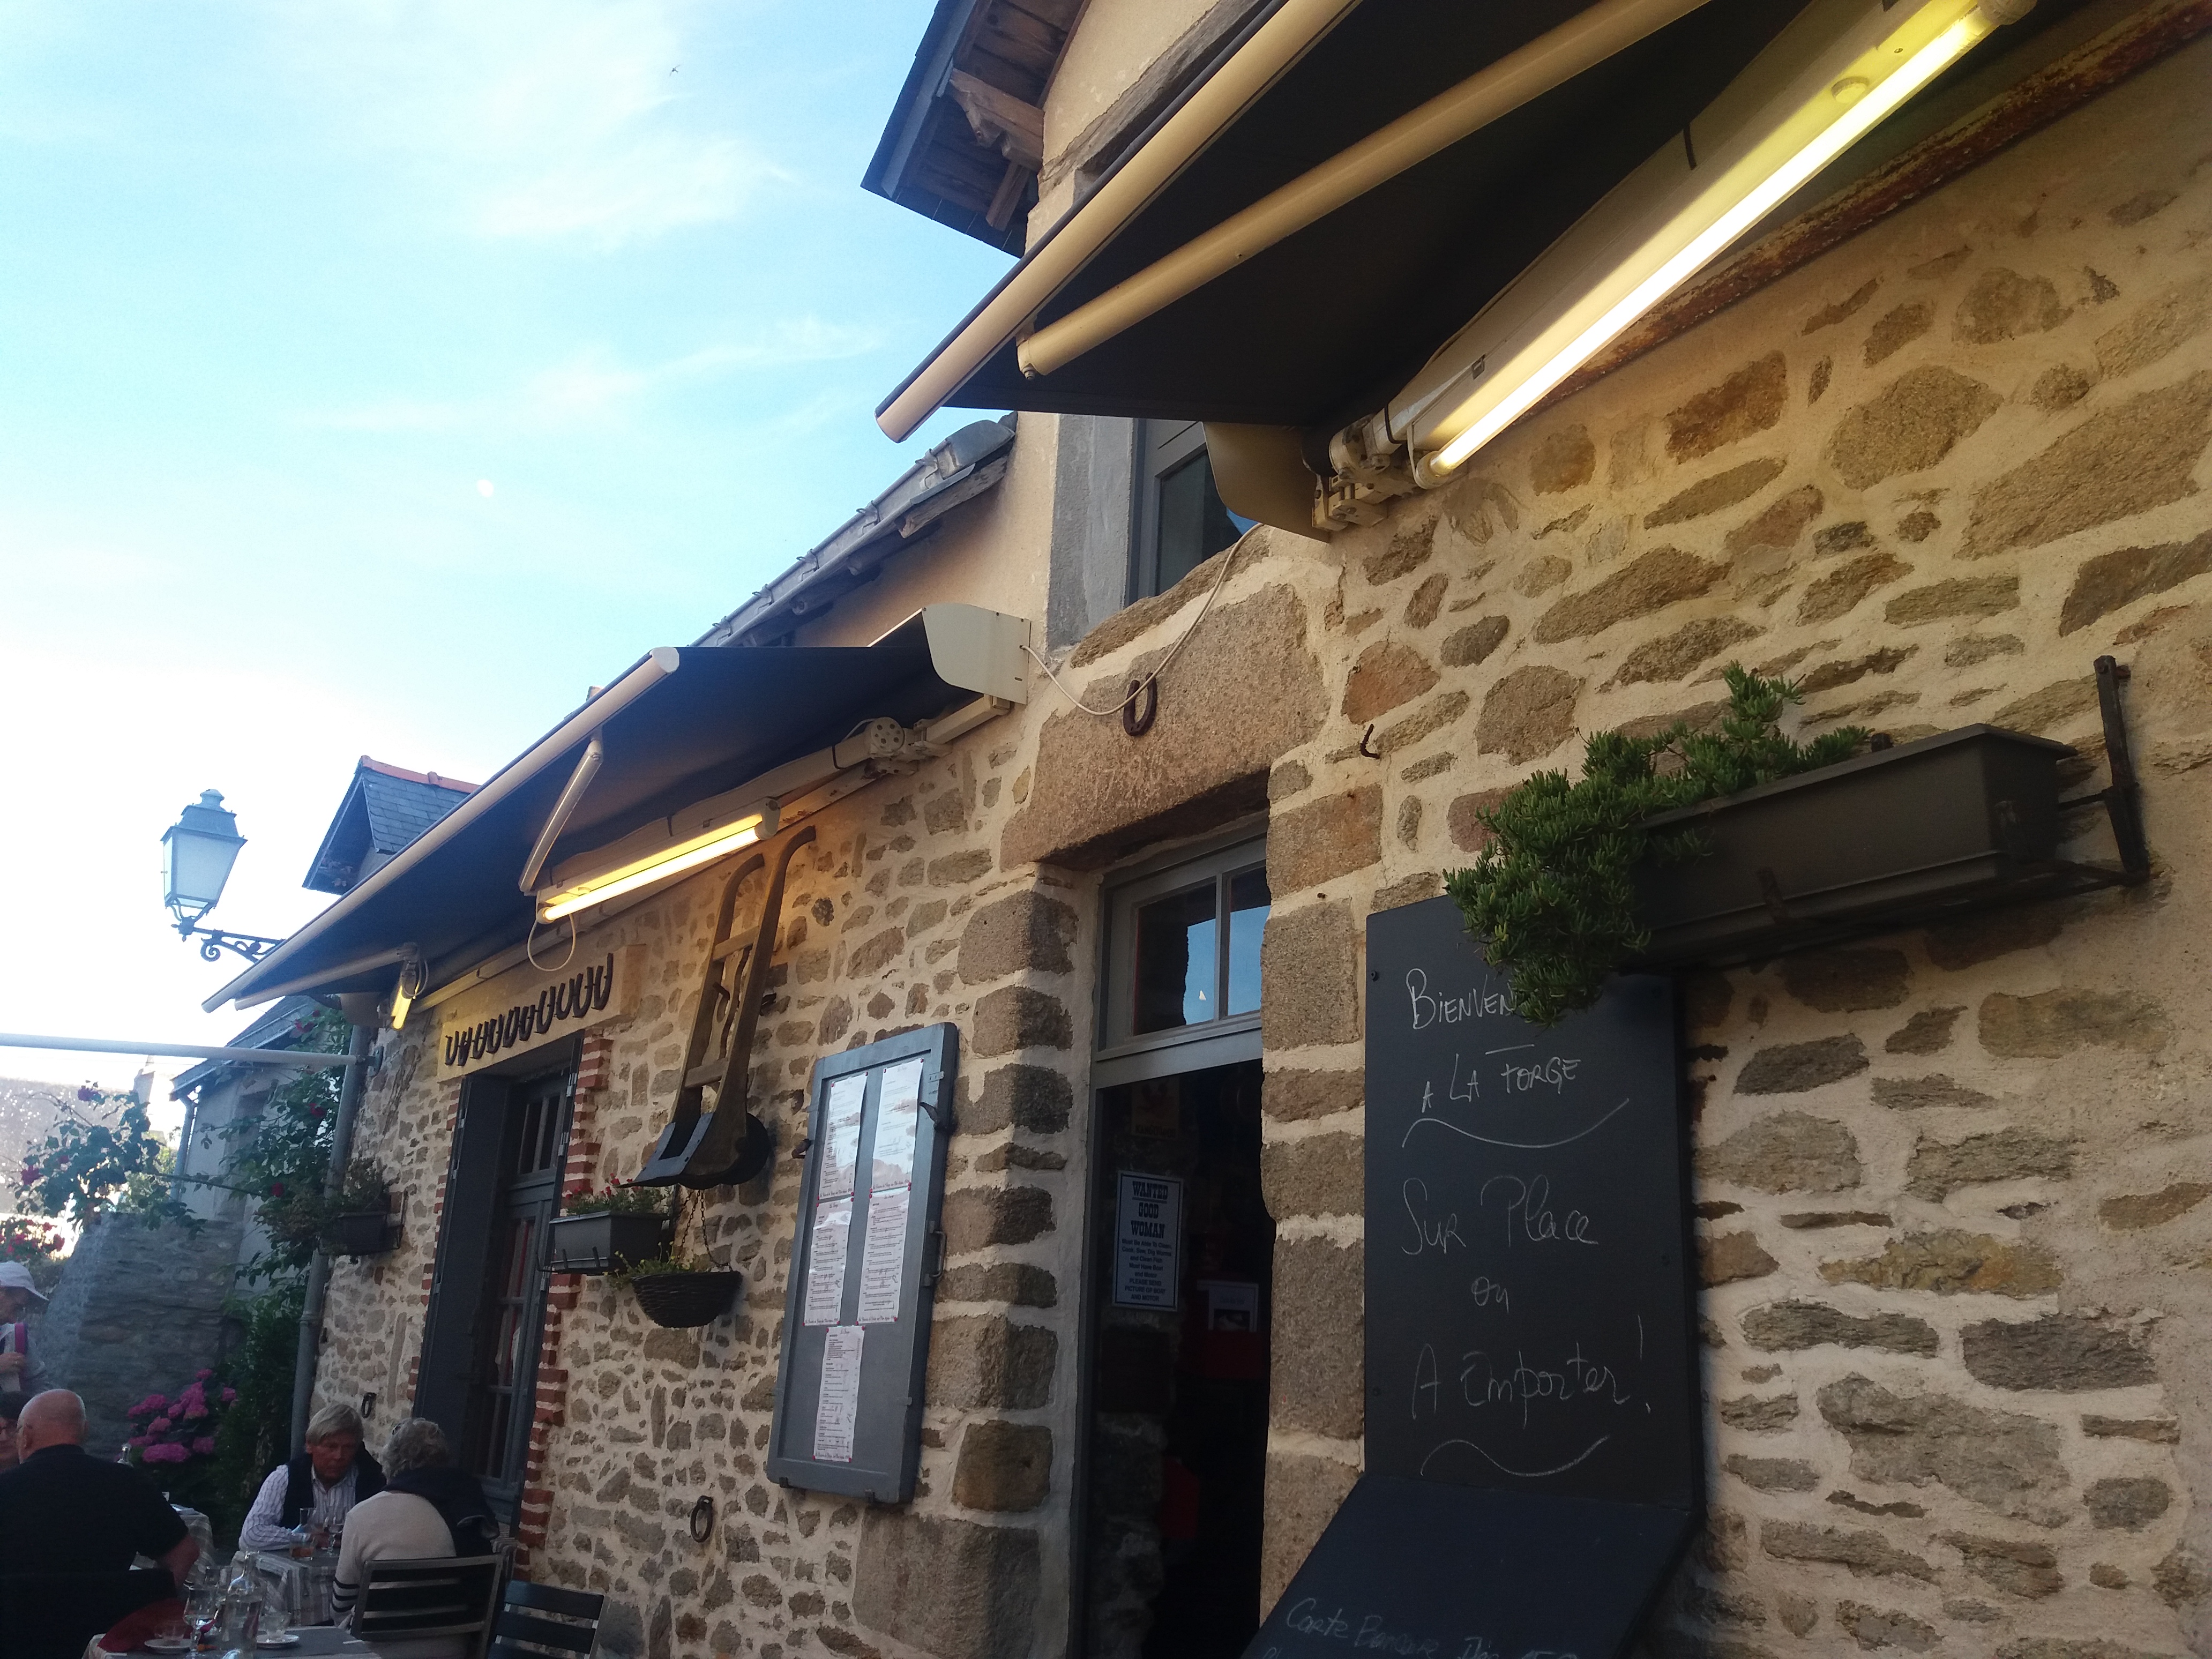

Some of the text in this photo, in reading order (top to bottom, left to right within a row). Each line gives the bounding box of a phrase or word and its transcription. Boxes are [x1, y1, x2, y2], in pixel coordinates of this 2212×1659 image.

[1405, 967, 1518, 1030] BIENVEN
[1421, 1080, 1434, 1114] A
[1449, 1052, 1481, 1103] LA
[1132, 1181, 1168, 1200] WANTED
[1139, 1202, 1159, 1219] GOOD
[1480, 1174, 1599, 1248] Place
[1131, 1220, 1165, 1238] WOMAN
[1411, 1342, 1441, 1421] A
